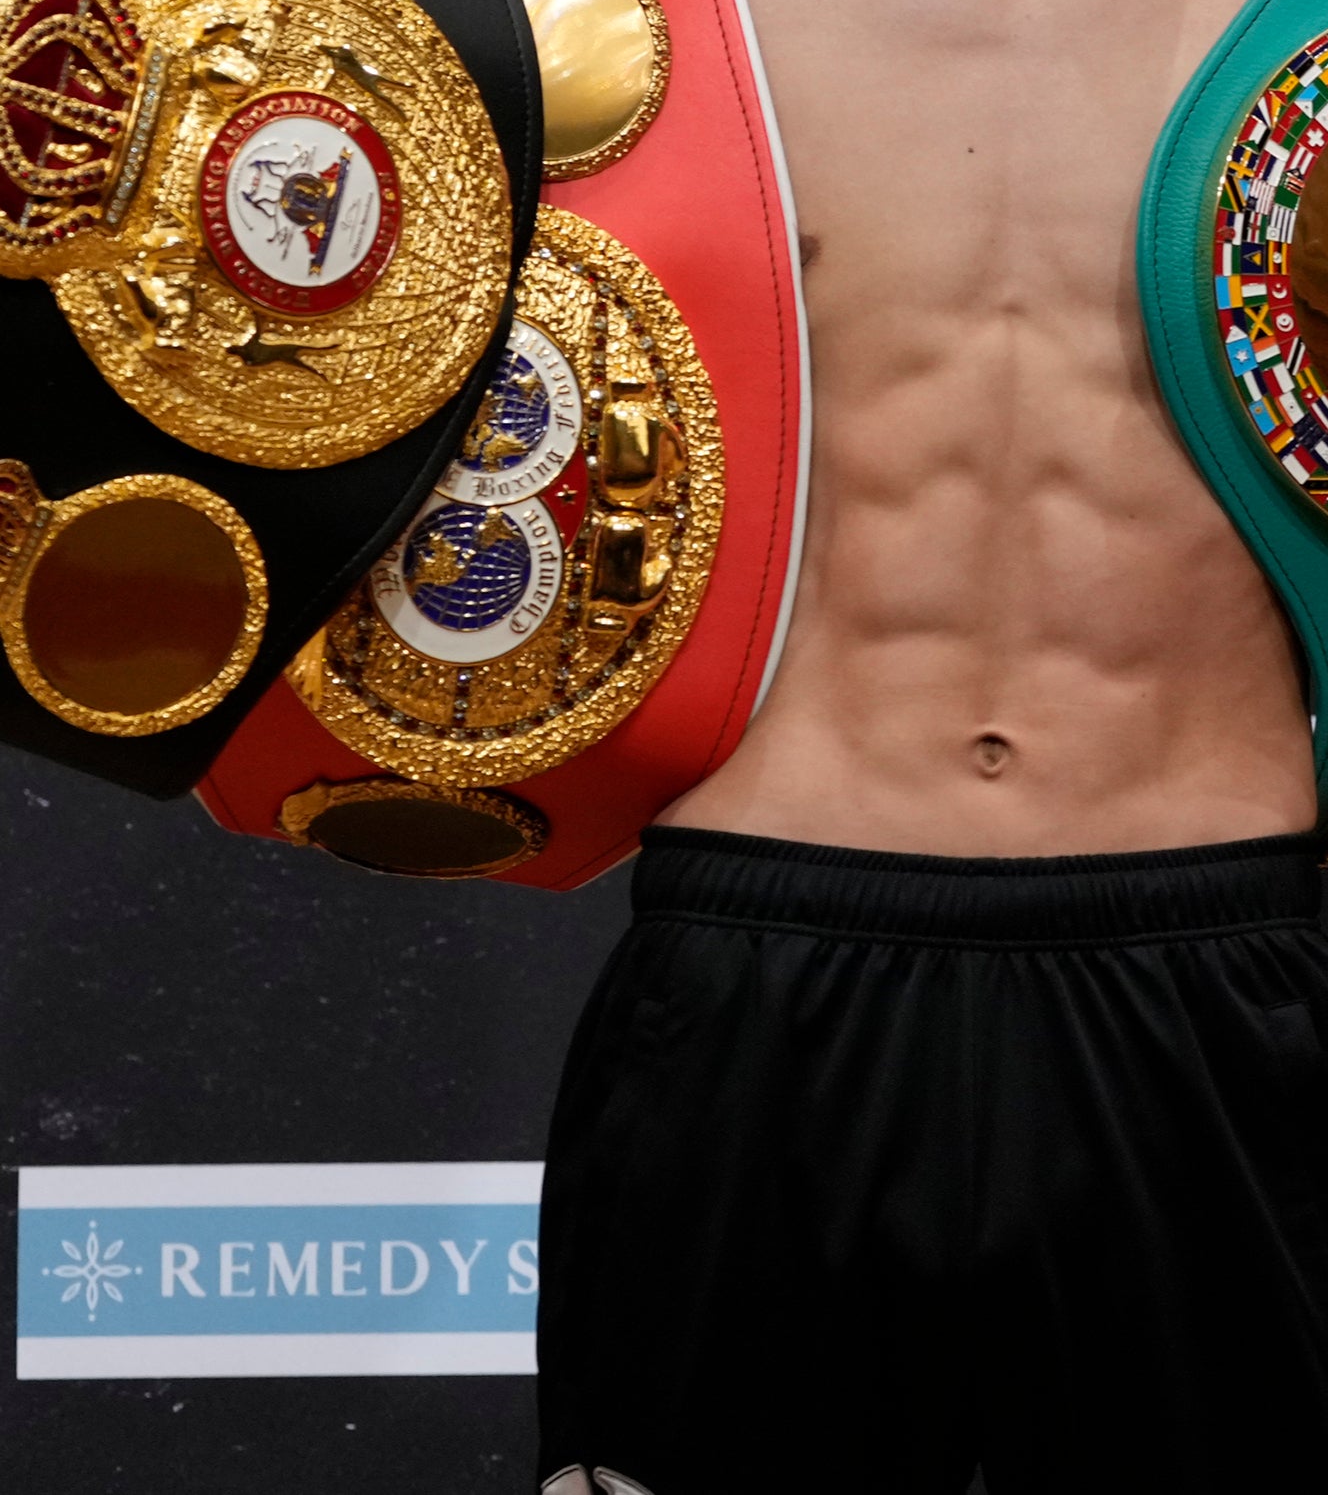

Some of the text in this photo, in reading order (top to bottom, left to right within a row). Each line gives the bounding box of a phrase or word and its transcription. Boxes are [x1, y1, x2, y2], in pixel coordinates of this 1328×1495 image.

[218, 98, 364, 153] ASSOCIATION
[472, 448, 565, 500] Boxing
[509, 509, 557, 634] Champion
